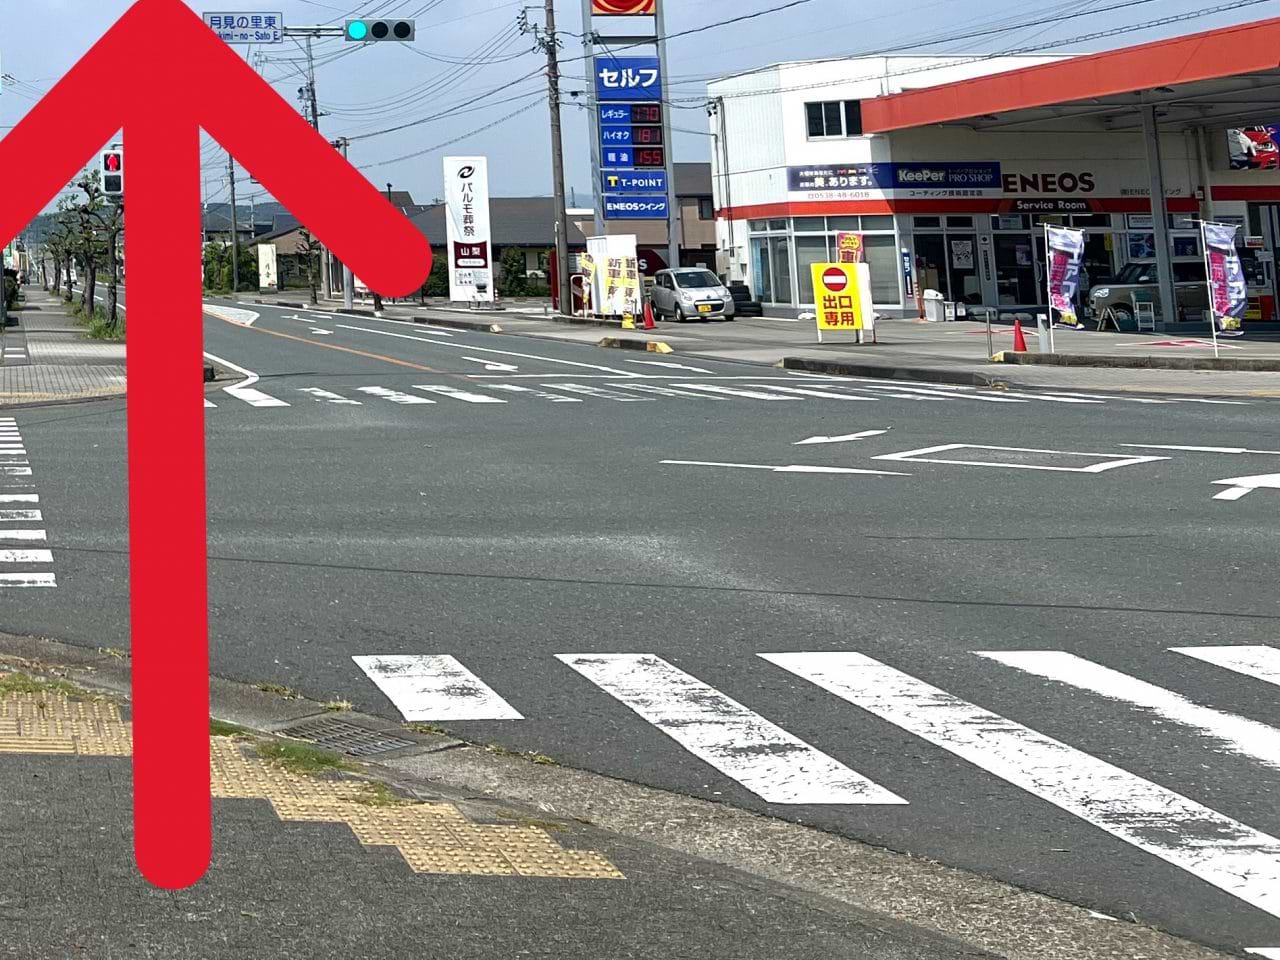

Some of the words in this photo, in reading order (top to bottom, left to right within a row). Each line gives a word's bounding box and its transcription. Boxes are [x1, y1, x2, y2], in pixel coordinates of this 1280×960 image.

[210, 16, 278, 29] 月見の里東
[599, 68, 658, 88] セルフ
[602, 109, 629, 119] レギュラー
[634, 107, 659, 121] 170
[603, 131, 630, 140] ハイオク
[639, 129, 660, 142] 181
[640, 150, 661, 164] 155
[897, 169, 945, 182] KeePer
[949, 174, 967, 182] PRO
[969, 174, 993, 182] SHOP
[621, 179, 663, 187] T-POINT
[1002, 172, 1095, 193] ENEOS
[606, 203, 665, 211] ENEOSウイング
[1017, 200, 1053, 209] Service
[1058, 200, 1086, 209] Room
[823, 295, 852, 309] 出口
[824, 311, 854, 325] 専用
